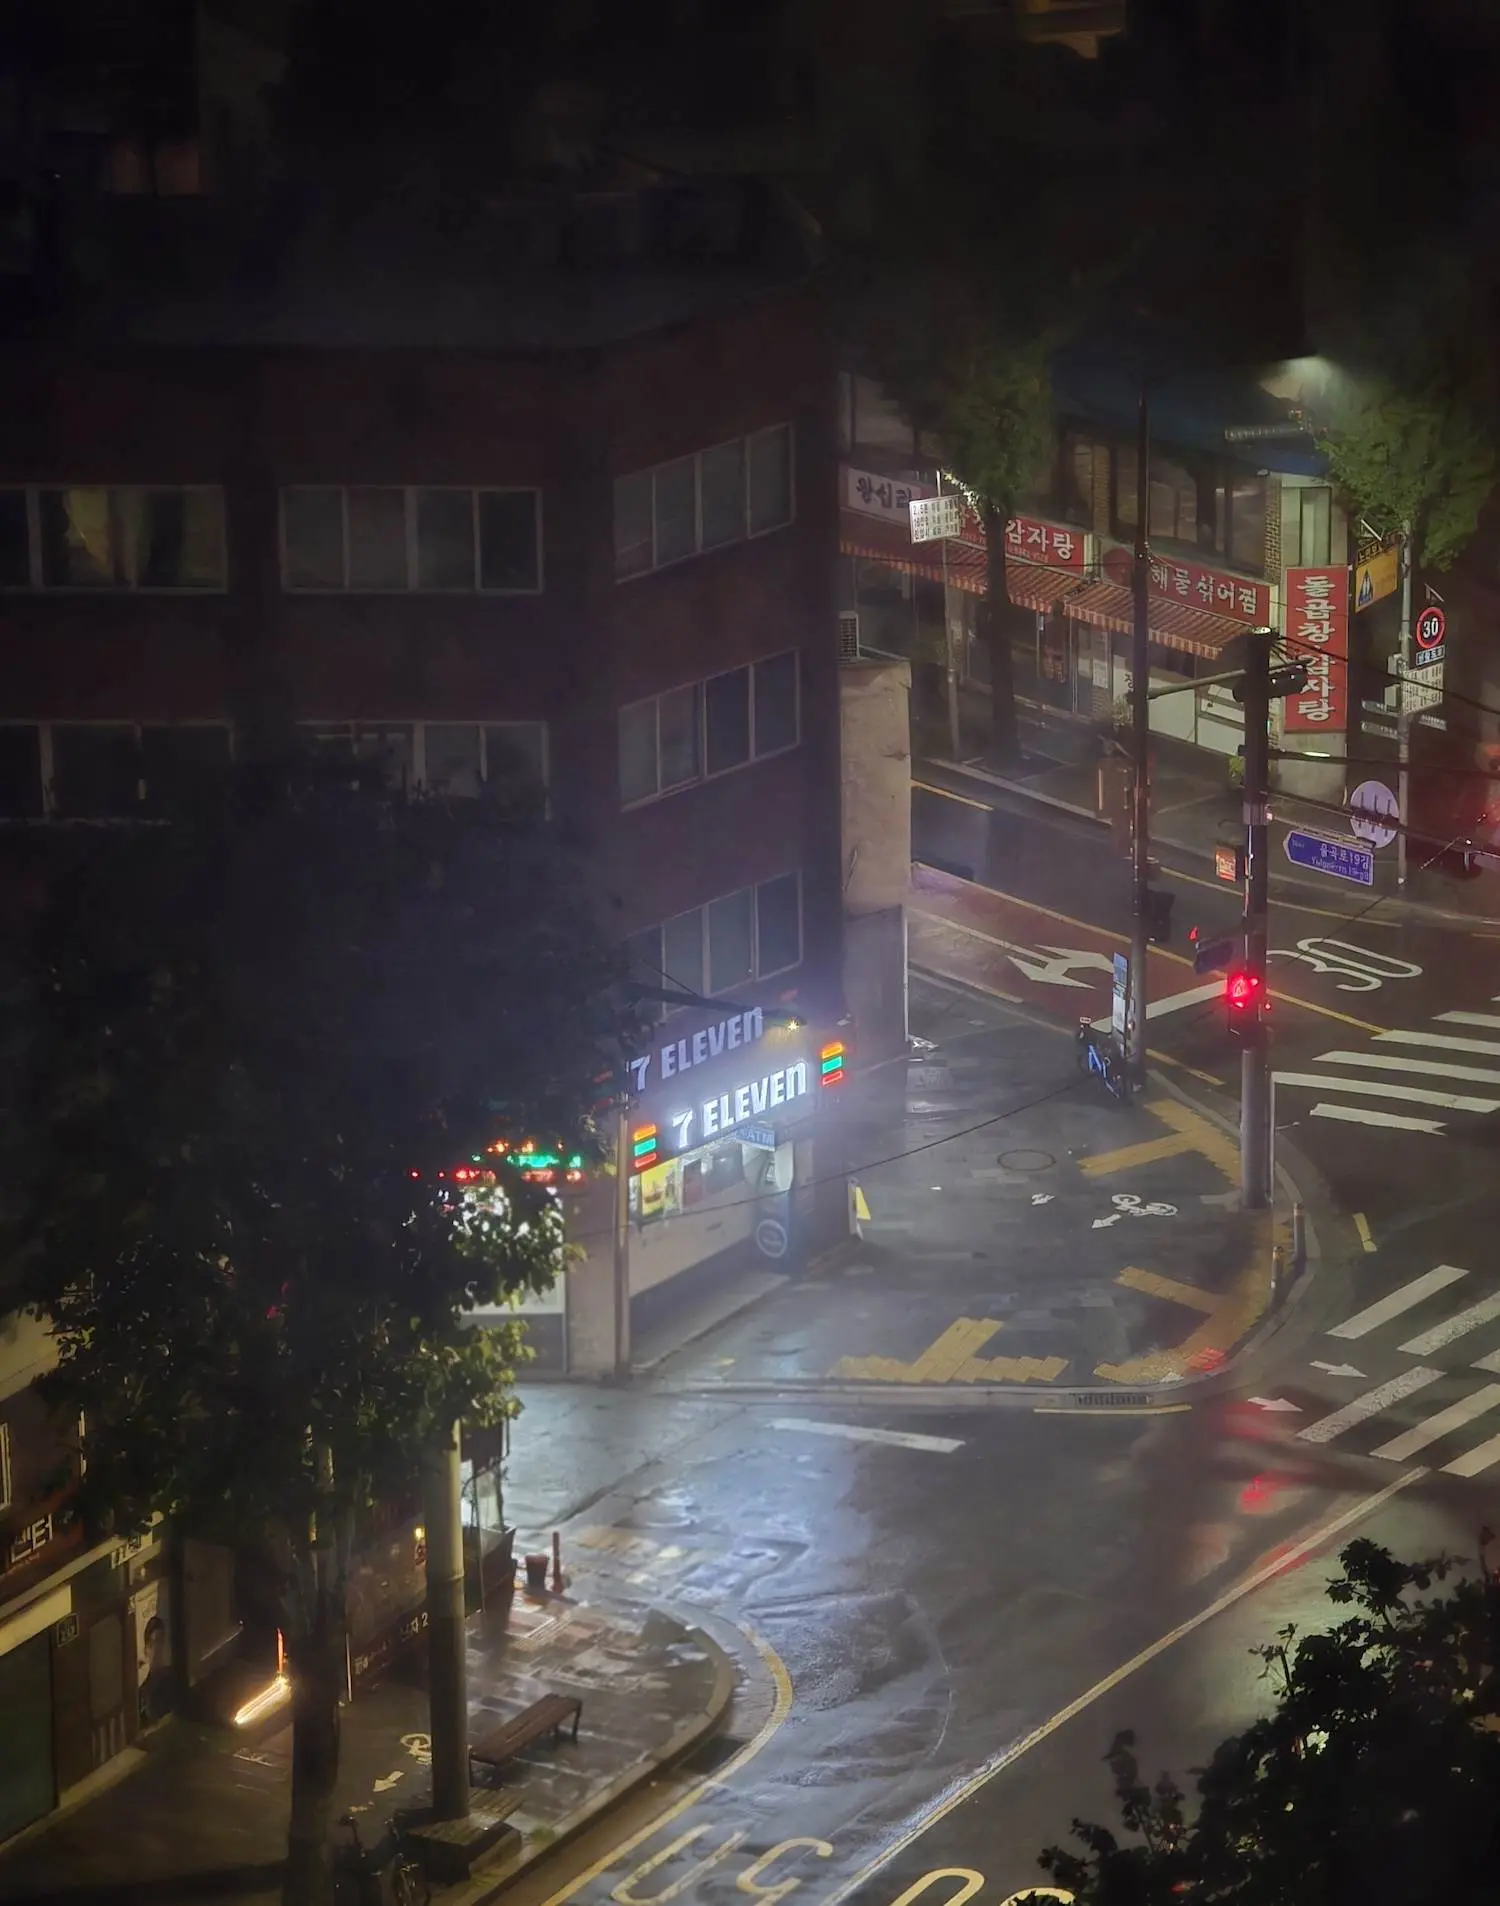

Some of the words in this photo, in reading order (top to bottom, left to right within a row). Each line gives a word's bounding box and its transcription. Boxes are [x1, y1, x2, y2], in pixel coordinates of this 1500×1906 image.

[1004, 518, 1075, 561] 감자탕
[1422, 617, 1440, 640] 30
[630, 1053, 652, 1092] 7
[672, 1107, 694, 1149] 7
